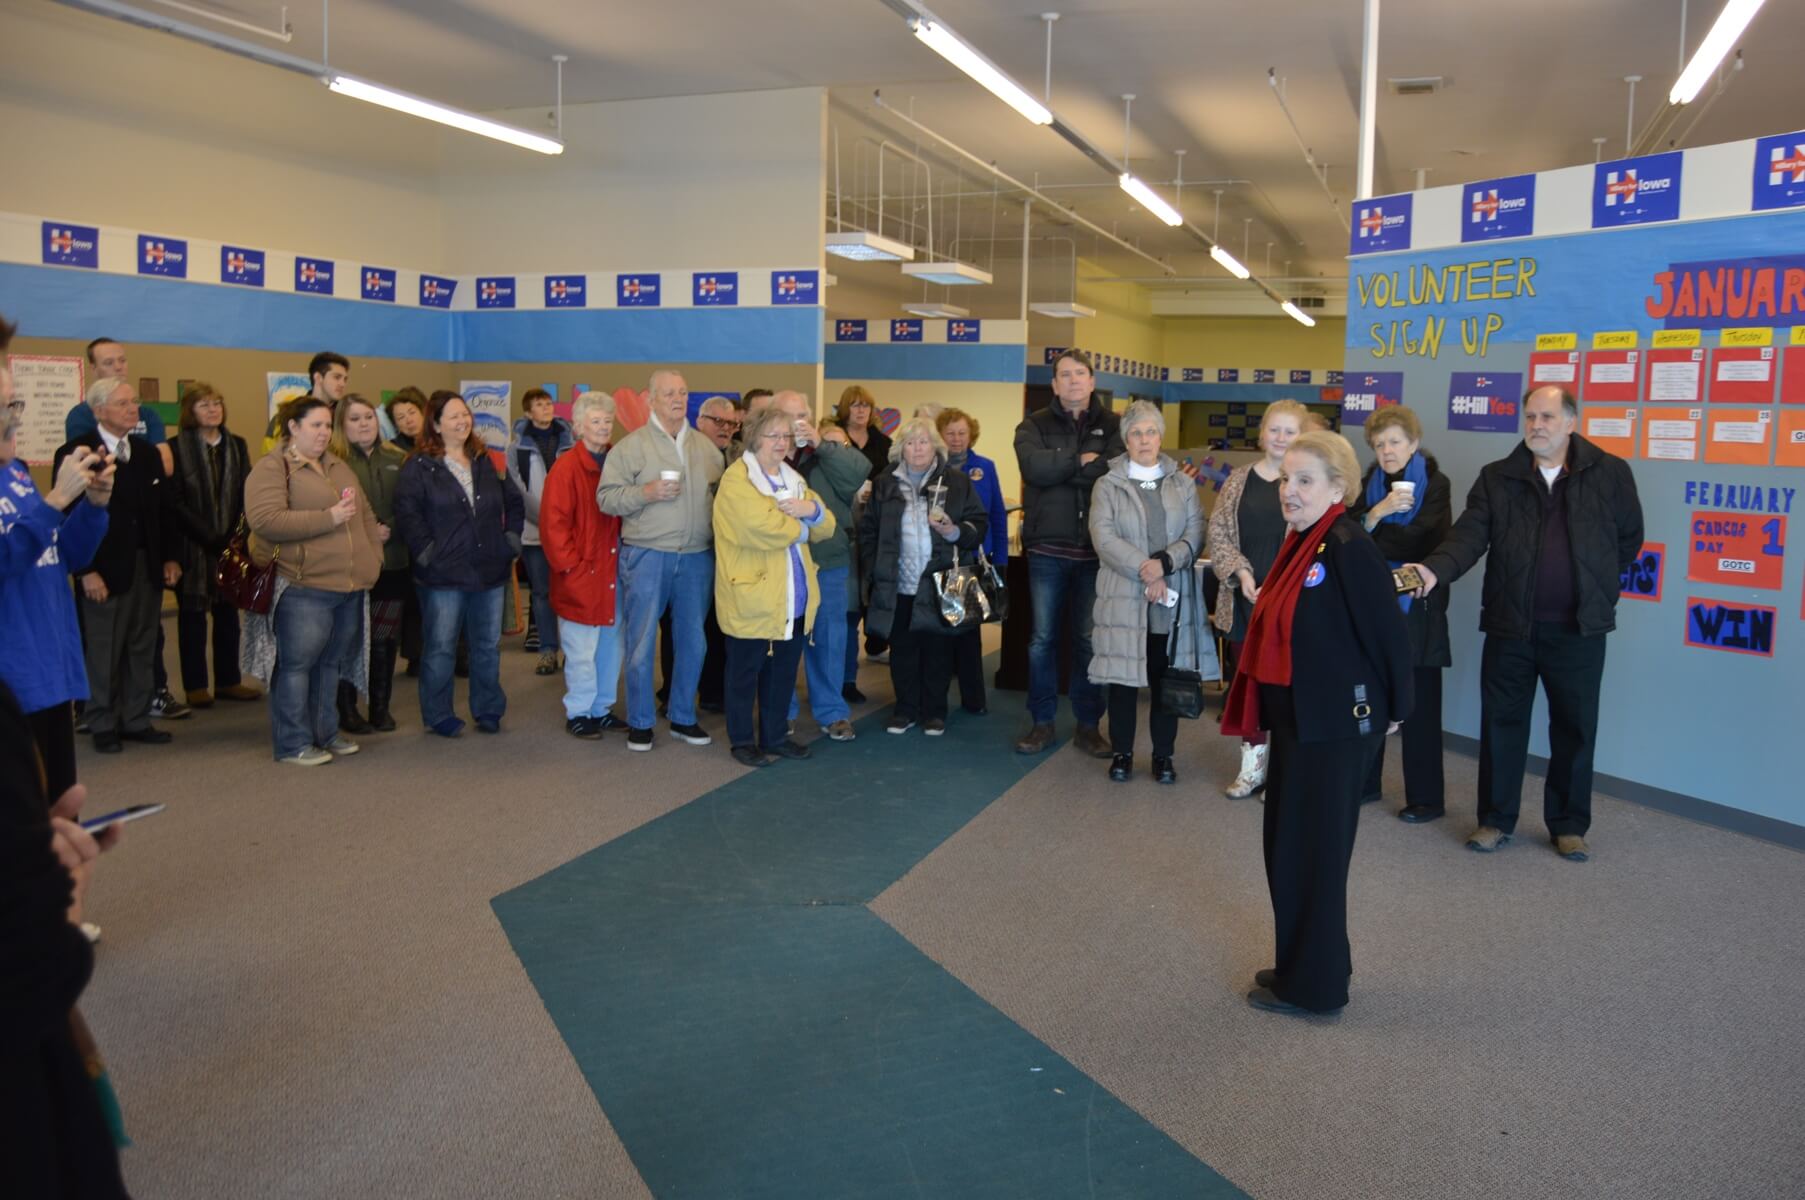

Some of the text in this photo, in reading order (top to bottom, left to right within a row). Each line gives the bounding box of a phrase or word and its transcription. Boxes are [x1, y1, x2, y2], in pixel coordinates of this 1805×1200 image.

[1638, 178, 1671, 191] Iowa
[1499, 198, 1526, 209] Iowa
[1383, 215, 1405, 225] Iowa
[1357, 257, 1538, 309] VOLUNTEER
[1645, 267, 1805, 319] JANUAR
[1370, 312, 1504, 360] SIGN UP
[1451, 396, 1516, 416] #HillYes
[1685, 481, 1795, 513] FEBRUARY
[1693, 519, 1747, 538] CAUCUS
[1761, 518, 1784, 556] 1
[1695, 541, 1724, 553] DAY
[1721, 560, 1752, 570] GOTC
[1692, 603, 1774, 653] WIN
